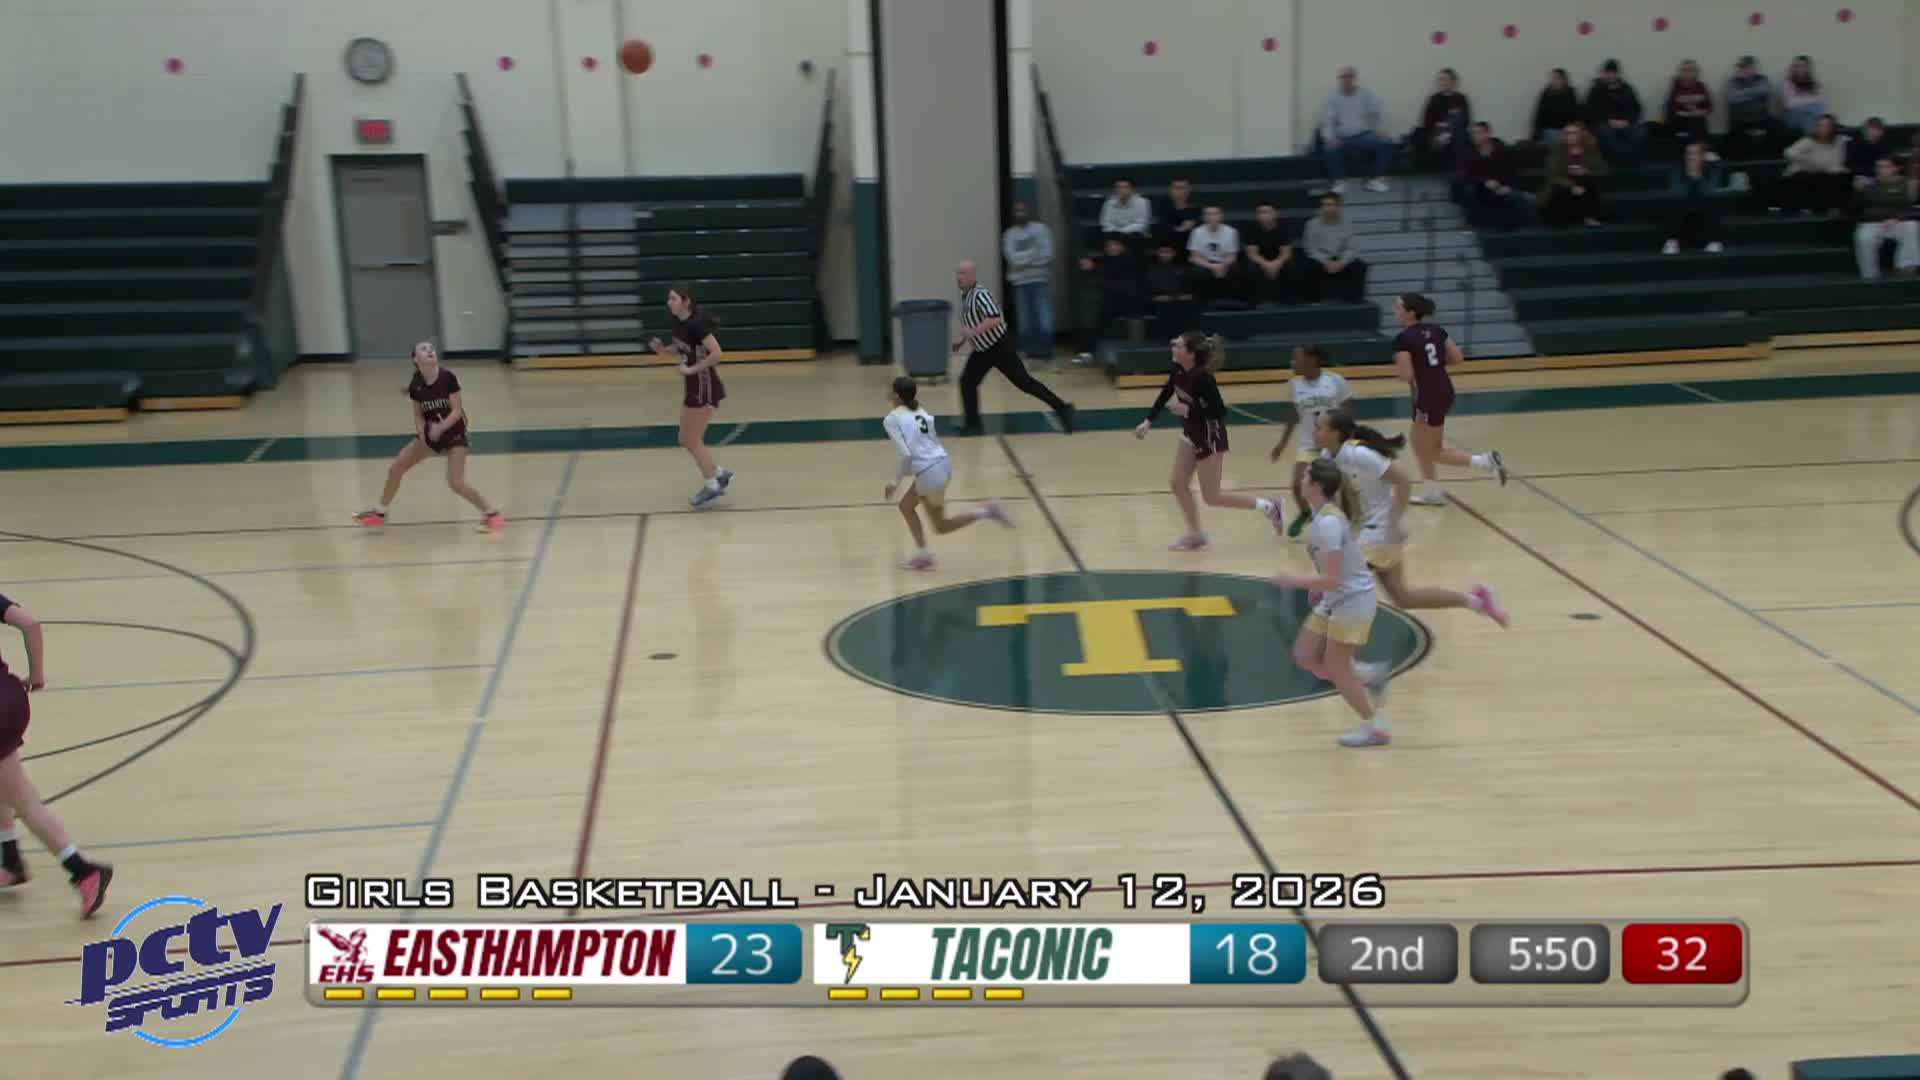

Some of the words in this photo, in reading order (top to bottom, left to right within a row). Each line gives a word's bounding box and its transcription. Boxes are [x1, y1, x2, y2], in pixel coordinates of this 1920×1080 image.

[1424, 343, 1440, 367] 2
[914, 415, 929, 434] 3
[977, 596, 1239, 676] T
